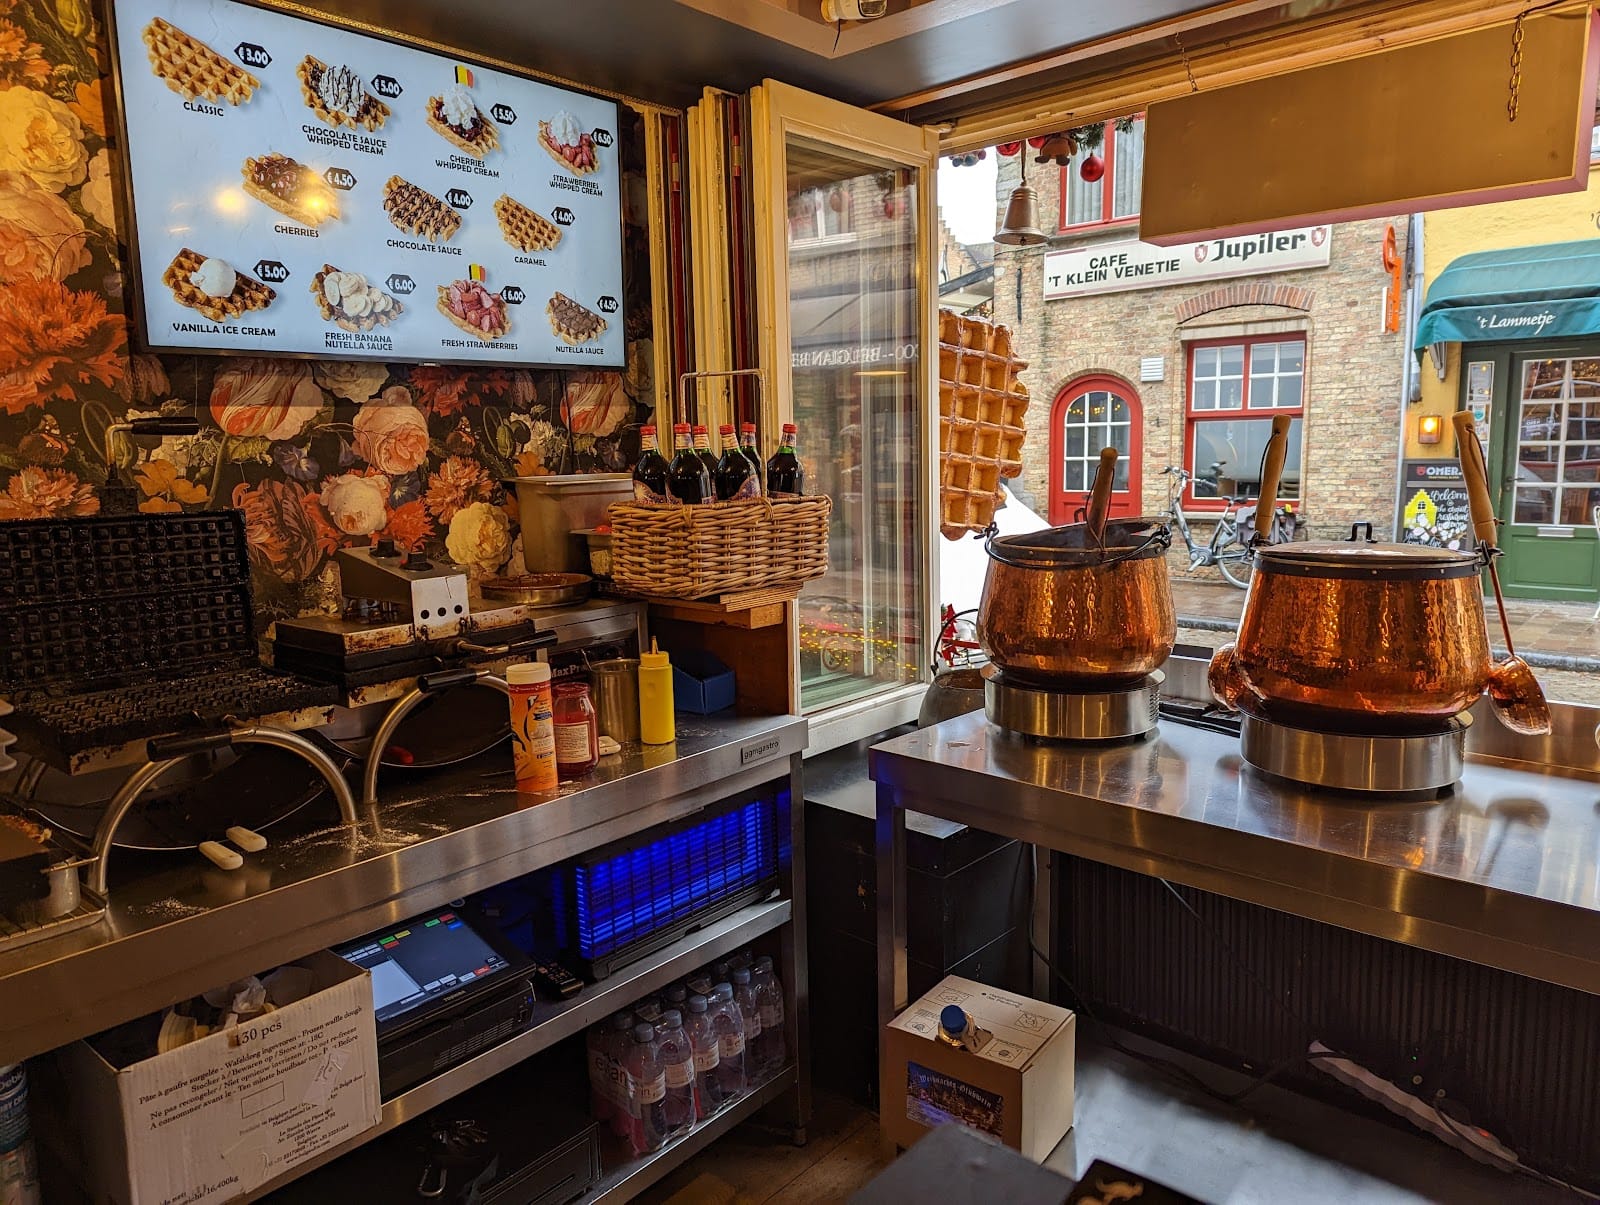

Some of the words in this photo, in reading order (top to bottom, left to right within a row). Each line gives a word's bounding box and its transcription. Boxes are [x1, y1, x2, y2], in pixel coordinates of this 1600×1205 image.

[183, 101, 224, 117] CLASSIC
[302, 124, 358, 142] CHOCOLATE
[360, 136, 388, 148] SAUCE
[306, 134, 350, 150] WHIPPED
[353, 143, 384, 156] CREAM
[436, 160, 472, 173] WHIPPED
[474, 167, 500, 178] CREAM
[450, 154, 485, 168] CHERRIES
[550, 181, 580, 192] WHIPPED
[582, 187, 602, 196] CREAM
[552, 174, 599, 190] STRAWBERRIES
[274, 225, 319, 238] CHERRIES
[386, 239, 436, 253] CHOCOLATE
[438, 245, 462, 256] SAUCE
[1211, 232, 1306, 262] Jupiler
[514, 256, 547, 266] CARAMEL
[1089, 254, 1128, 270] CAFE
[1048, 276, 1061, 288] 'T
[1066, 269, 1108, 286] KLEIN
[1114, 258, 1180, 280] VENETIE
[172, 322, 220, 334] VANILLA
[222, 326, 240, 336] ICE
[241, 326, 276, 337] CREAM
[1489, 310, 1556, 336] Lammetje
[325, 332, 352, 341] FRESH
[354, 334, 392, 344] BANANA
[325, 340, 364, 350] NUTELLA
[366, 343, 393, 351] SAUCE
[442, 339, 464, 348] FRESH
[466, 340, 518, 350] STRAWBERRIES
[236, 1028, 257, 1045] 130
[261, 1021, 282, 1039] pcs
[164, 1082, 188, 1097] gaufre
[326, 1016, 342, 1027] waffle
[191, 1077, 219, 1092] Stocker
[232, 1060, 262, 1076] Bewaren
[278, 1044, 296, 1056] Store
[150, 1110, 162, 1120] Ne
[164, 1105, 177, 1116] pas
[178, 1087, 218, 1108] recongeler
[224, 1078, 240, 1089] Niet
[308, 1045, 318, 1053] Do
[319, 1040, 328, 1048] not
[150, 1122, 156, 1130] A
[203, 1095, 224, 1108] avant
[238, 1083, 252, 1092] Ten
[338, 1034, 358, 1048] Before
